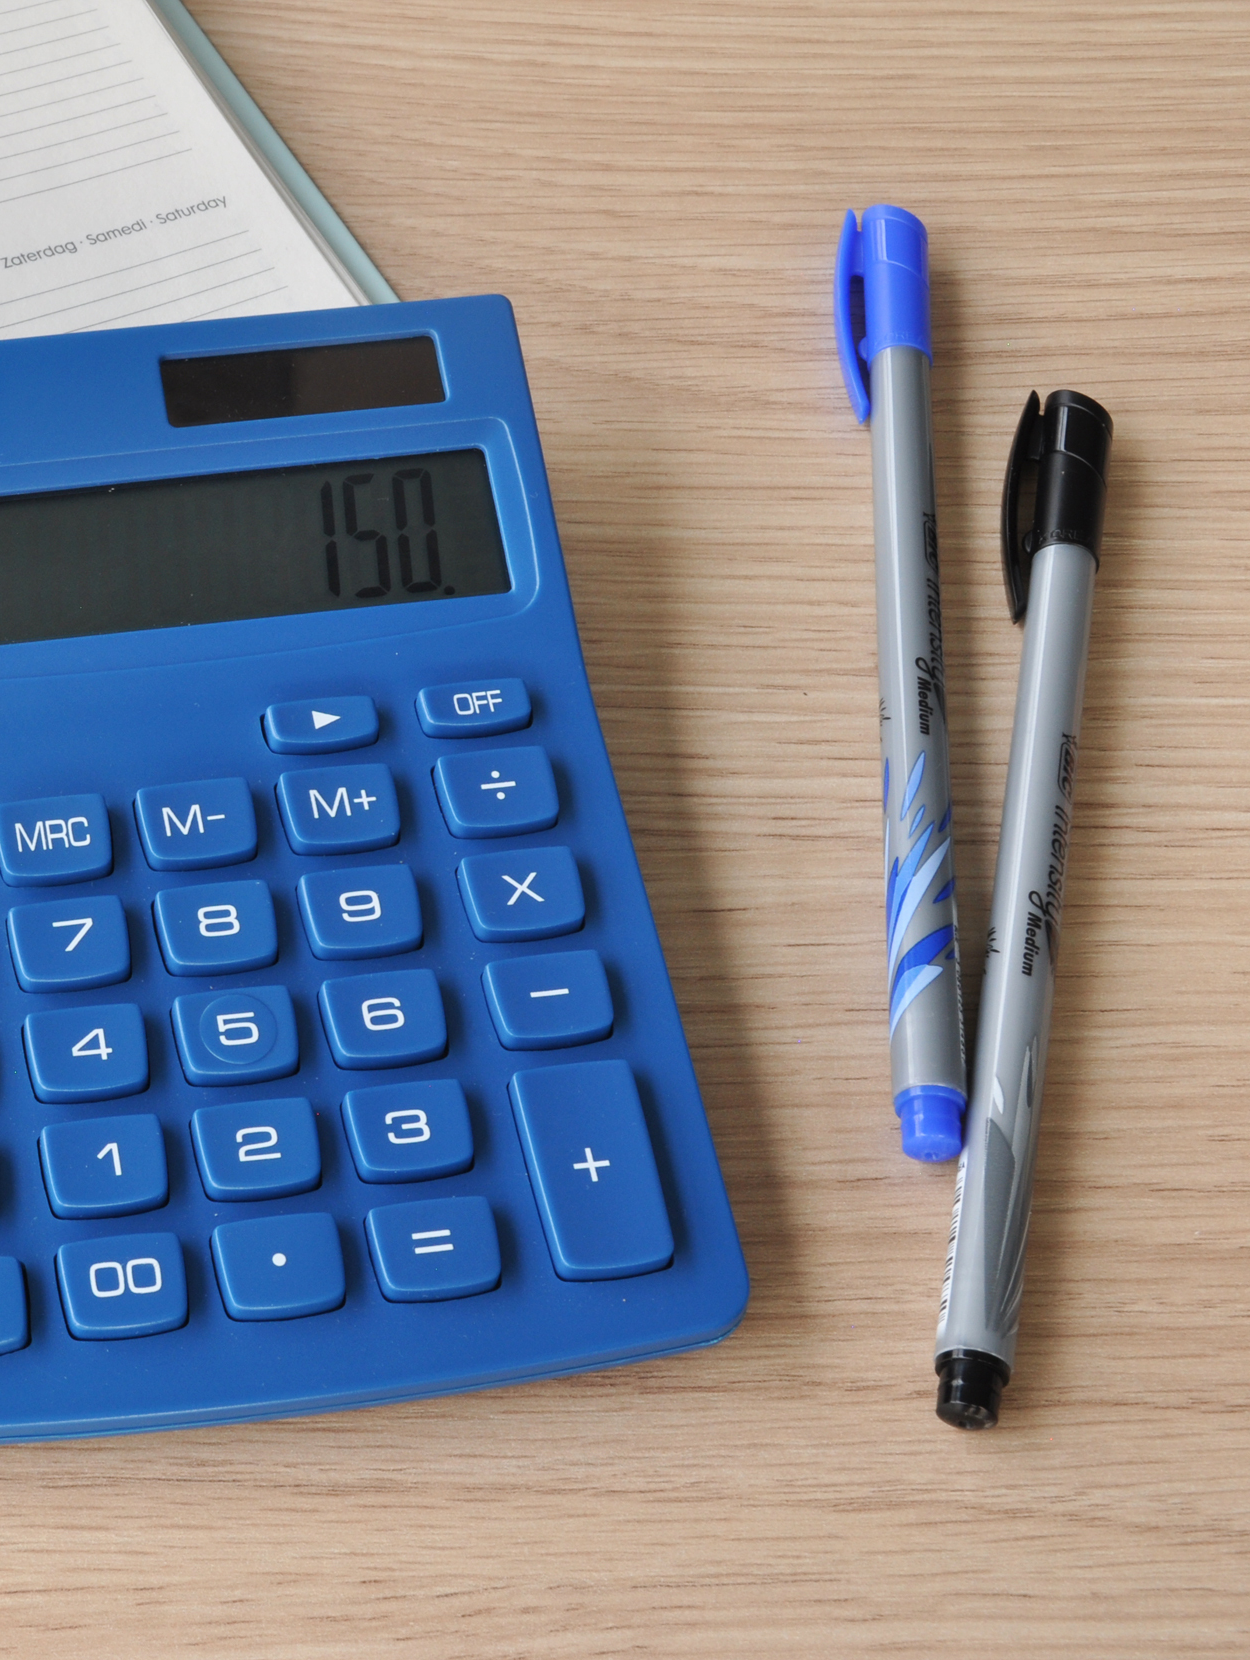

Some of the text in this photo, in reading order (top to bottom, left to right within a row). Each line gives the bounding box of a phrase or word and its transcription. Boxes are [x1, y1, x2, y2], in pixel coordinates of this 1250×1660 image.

[0, 195, 227, 270] Zaterdag Samedi Saturday
[453, 689, 503, 716] OFF
[915, 675, 934, 737] Medium
[308, 786, 377, 819] M+
[14, 816, 91, 853] MRC
[197, 904, 241, 937] 8
[338, 890, 382, 923] 9
[52, 917, 94, 952] 7
[1021, 911, 1043, 977] Medium
[216, 1011, 260, 1046] 5
[361, 996, 405, 1031] 6
[71, 1027, 113, 1061] 4
[235, 1125, 282, 1162] 2
[384, 1109, 431, 1145] 3
[96, 1142, 122, 1176] 1
[89, 1257, 163, 1298] 00
